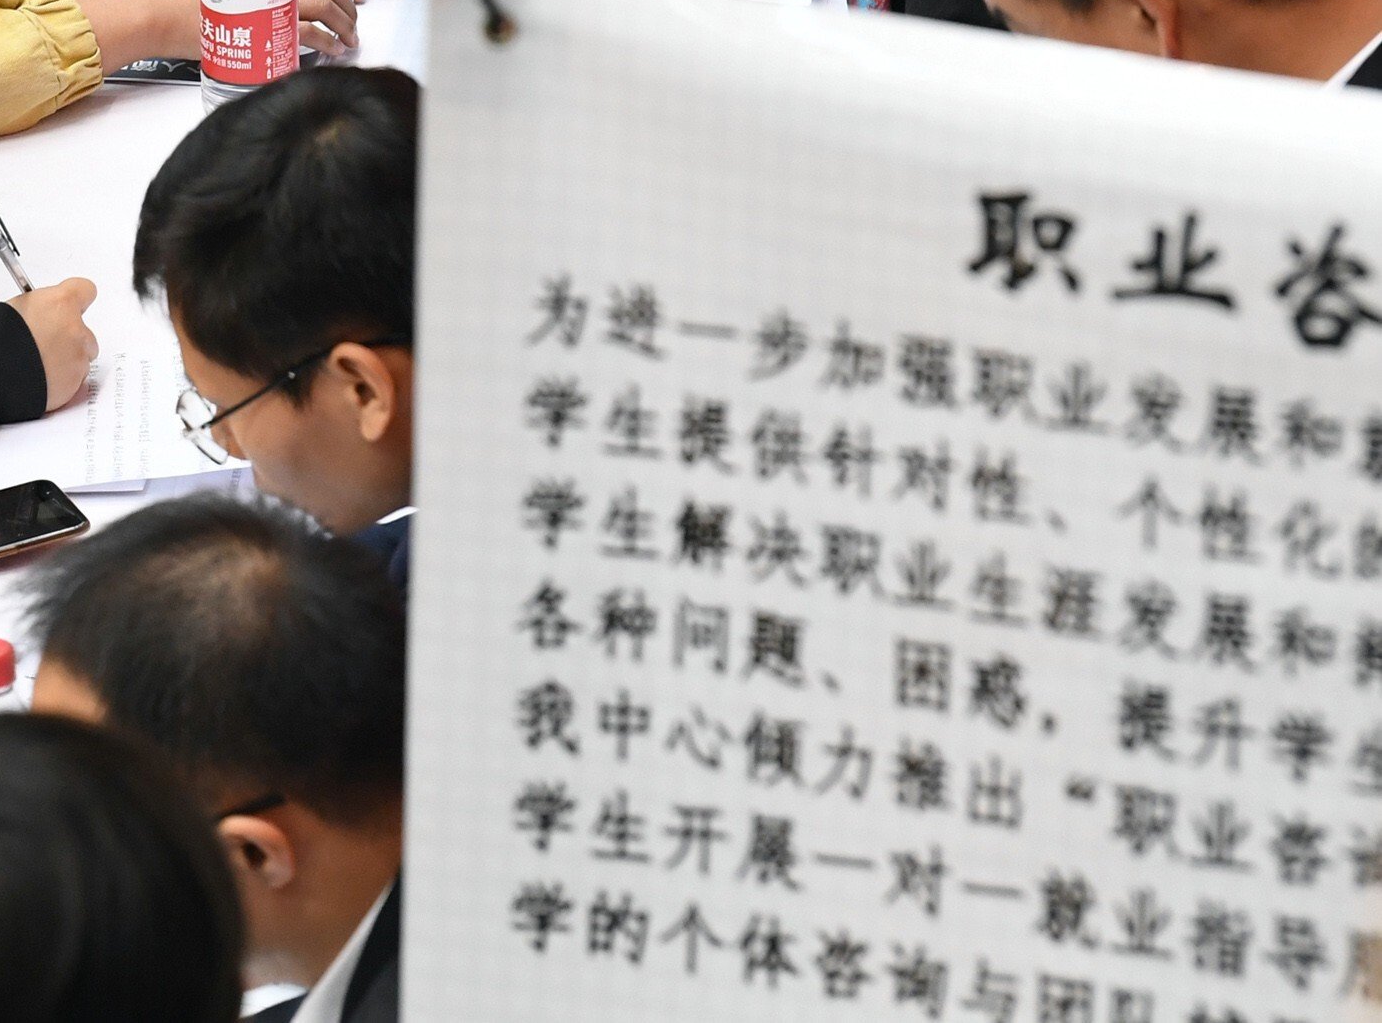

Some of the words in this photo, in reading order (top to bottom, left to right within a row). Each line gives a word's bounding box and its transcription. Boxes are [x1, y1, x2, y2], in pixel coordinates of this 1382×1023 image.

[198, 14, 252, 48] 夫山泉
[216, 44, 252, 61] SPRING
[965, 189, 1382, 351] 职业咨
[512, 781, 1382, 1001] 学生开展一对一就业指导
